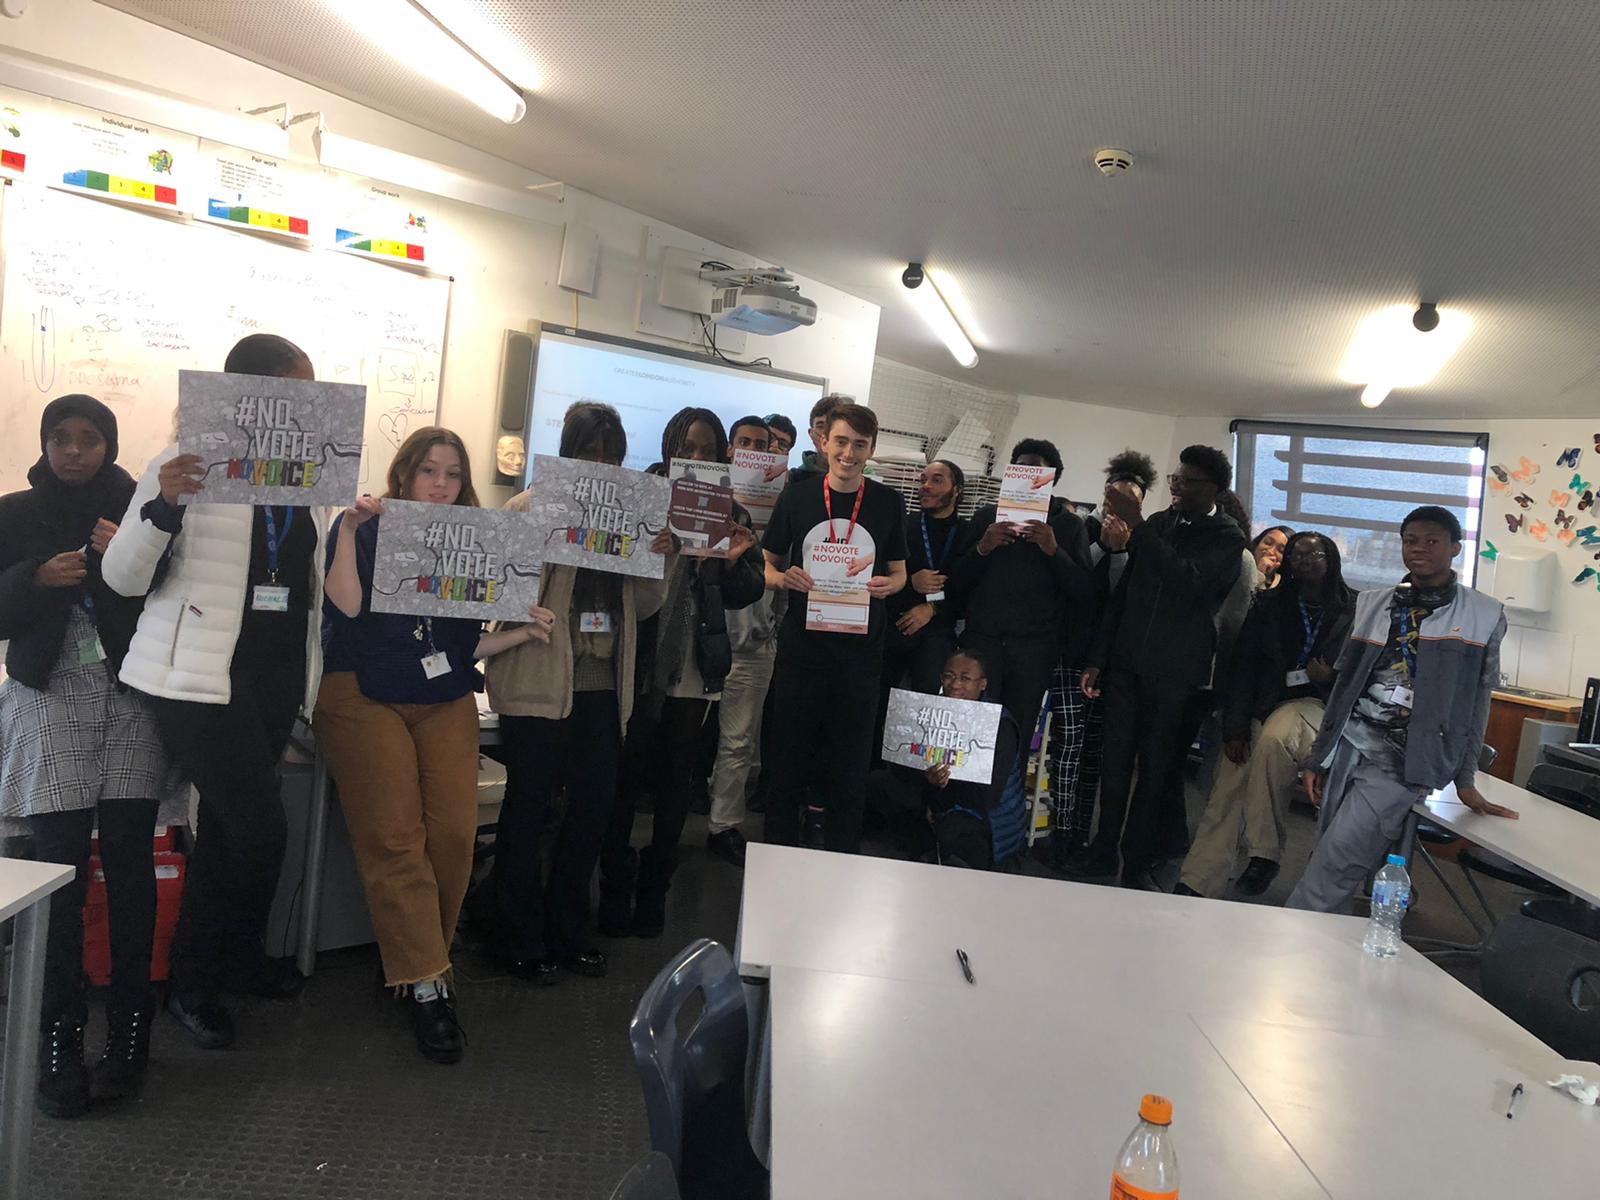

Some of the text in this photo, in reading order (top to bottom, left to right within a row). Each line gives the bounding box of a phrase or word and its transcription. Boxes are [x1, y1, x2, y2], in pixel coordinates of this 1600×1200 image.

[102, 116, 133, 129] Individual
[133, 126, 150, 134] work
[251, 155, 277, 168] Pair work
[371, 186, 400, 199] Group work
[235, 395, 292, 429] #NO
[545, 418, 565, 429] STE
[254, 429, 317, 461] VOTE
[672, 461, 730, 473] #NOVOTENOVOICE
[735, 451, 777, 463] #NOVOTE
[735, 460, 773, 472] NOVOICE
[227, 458, 317, 488] NOVOICE
[1006, 466, 1044, 474] #NOVOTE
[574, 476, 617, 506] #NO
[587, 503, 633, 535] VOTE
[425, 522, 476, 550] #NO
[566, 526, 632, 560] NOVOICE
[812, 554, 856, 565] NOVOICE
[813, 545, 860, 556] #NOVOTE
[441, 550, 498, 579] VOTE
[417, 575, 497, 604] NOVOICE
[918, 707, 952, 729] #NO
[927, 727, 966, 749] VOTE
[910, 742, 966, 768] NOVOICE
